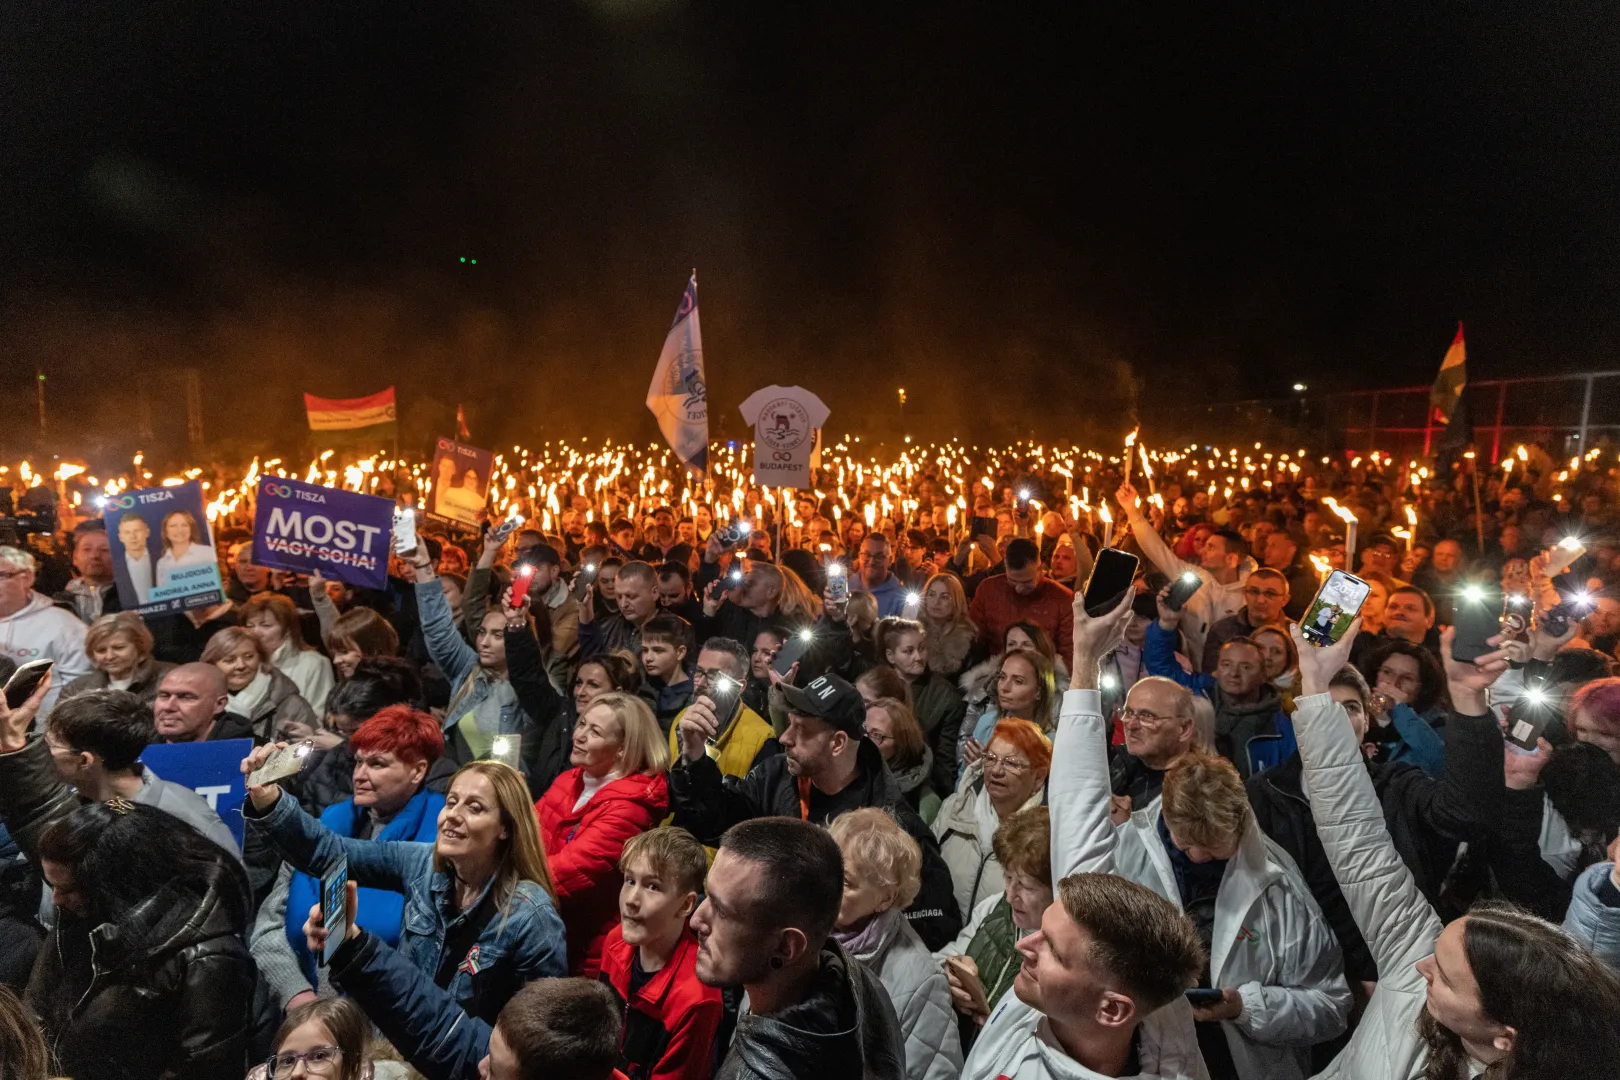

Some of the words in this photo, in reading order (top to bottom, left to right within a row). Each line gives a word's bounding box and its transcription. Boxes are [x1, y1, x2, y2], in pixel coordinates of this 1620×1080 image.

[457, 446, 478, 459] TISZA
[759, 462, 803, 472] BUDAPEST
[138, 490, 174, 504] TISZA
[294, 489, 326, 504] TISZA
[265, 507, 381, 553] MOST
[264, 536, 315, 558] VAGY
[318, 546, 377, 570] SOHA!
[153, 586, 190, 598] ANDREA
[191, 580, 216, 591] ANNA
